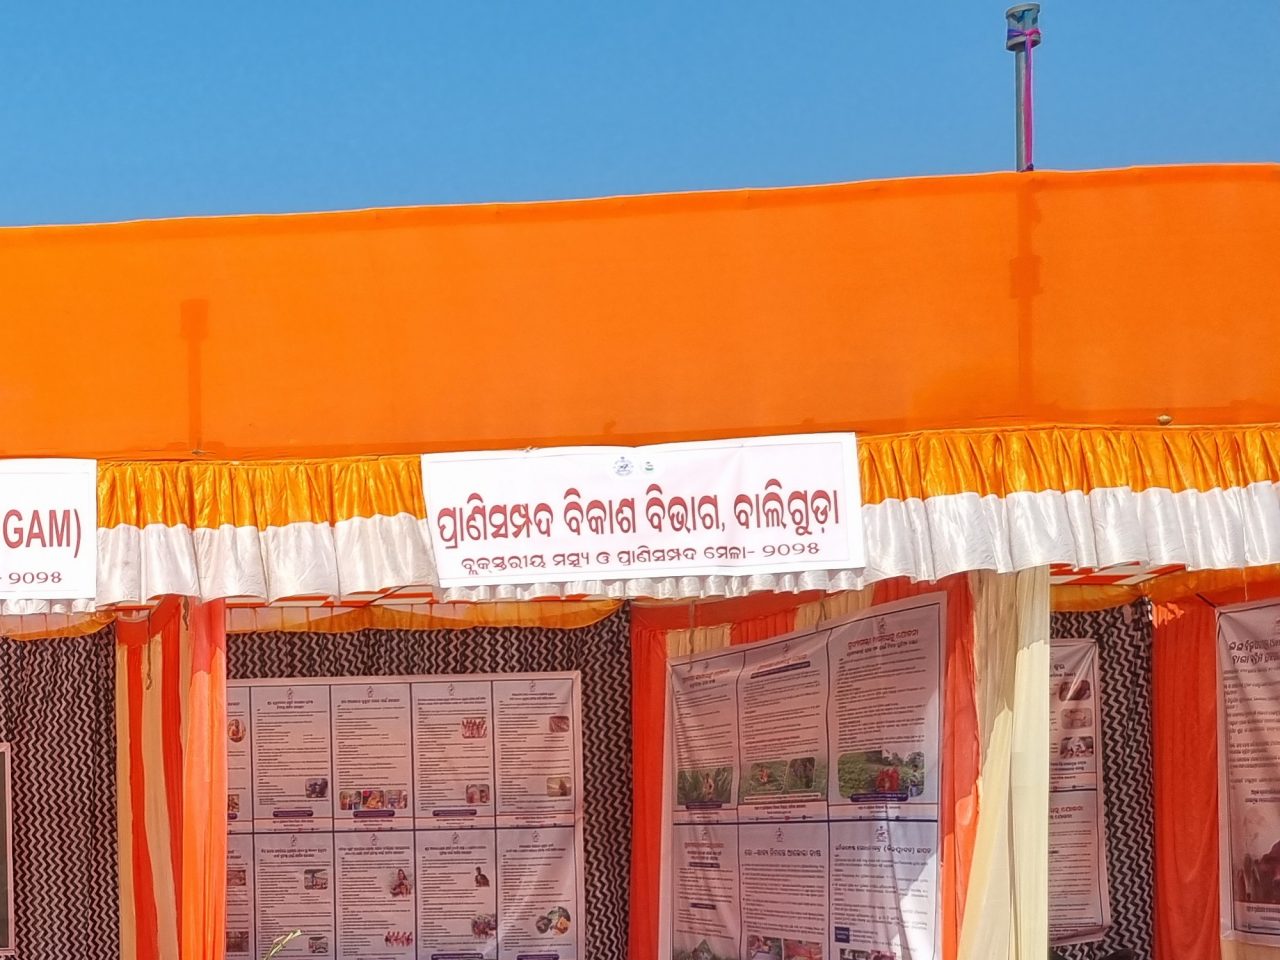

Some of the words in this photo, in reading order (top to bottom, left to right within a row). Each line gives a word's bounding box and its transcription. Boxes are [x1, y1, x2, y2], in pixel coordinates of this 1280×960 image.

[437, 492, 554, 549] ପ୍ରାଣିସମ୍ପଦ
[563, 487, 637, 537] ବିକାଶ
[645, 484, 726, 534] ବିଭାଗ,
[733, 478, 840, 536] ବାଲିଗୁଡ଼ା
[552, 552, 590, 570] ମତ୍ସ୍ୟ
[595, 552, 610, 565] ଓ
[617, 545, 697, 567] ପ୍ରାଣିସମ୍ପଦ
[762, 542, 821, 557] ୨୦୨୫
[8, 571, 63, 585] ୨୦୨୫
